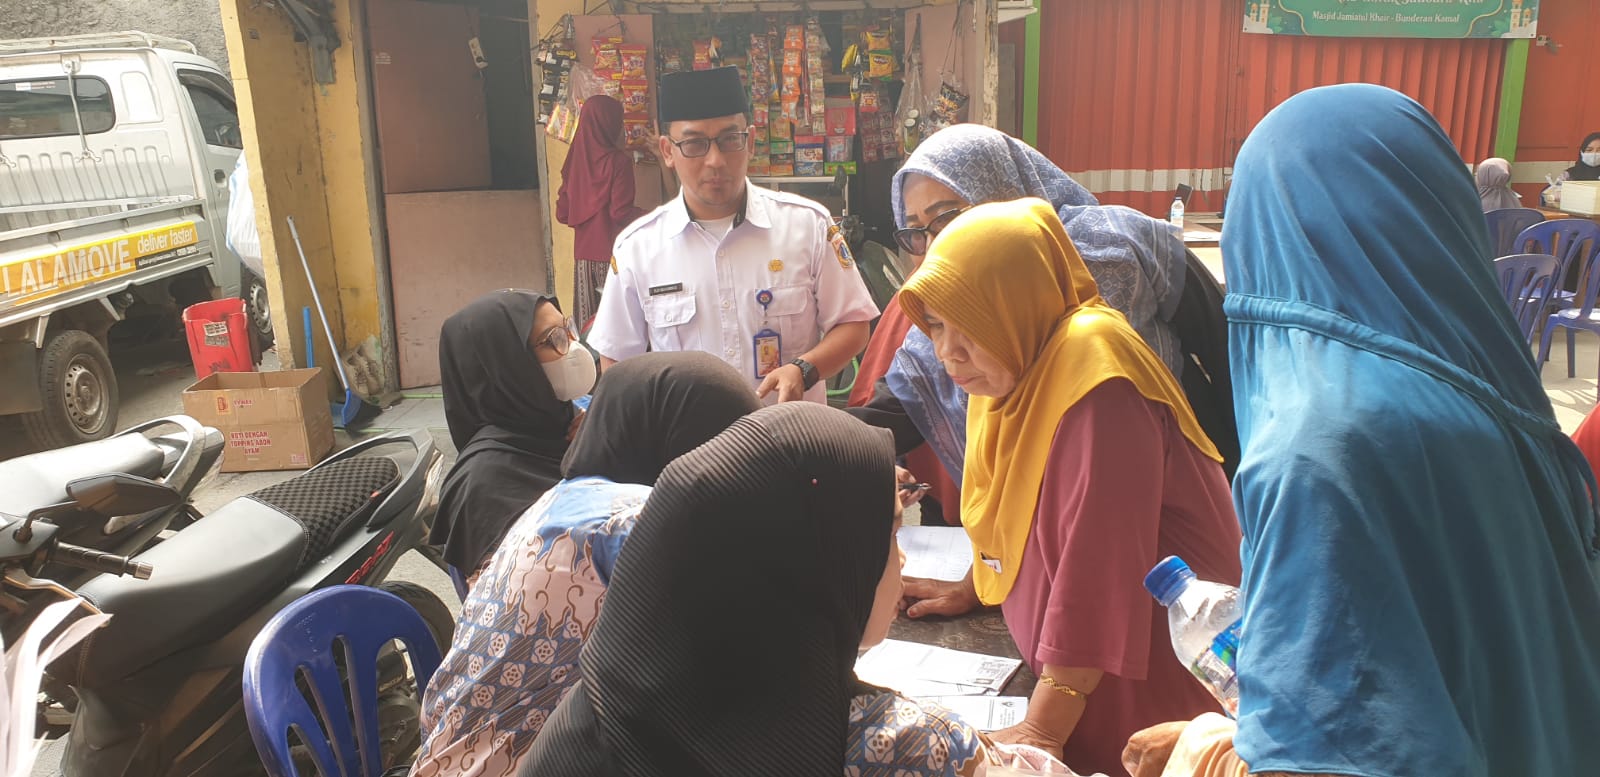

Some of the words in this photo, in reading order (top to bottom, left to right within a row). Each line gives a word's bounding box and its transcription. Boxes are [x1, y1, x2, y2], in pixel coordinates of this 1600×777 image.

[1312, 10, 1336, 22] Masjid
[1395, 13, 1433, 23] Bunderan
[2, 239, 132, 298] LALAMOVE
[137, 234, 168, 254] deliver
[169, 228, 193, 246] faster
